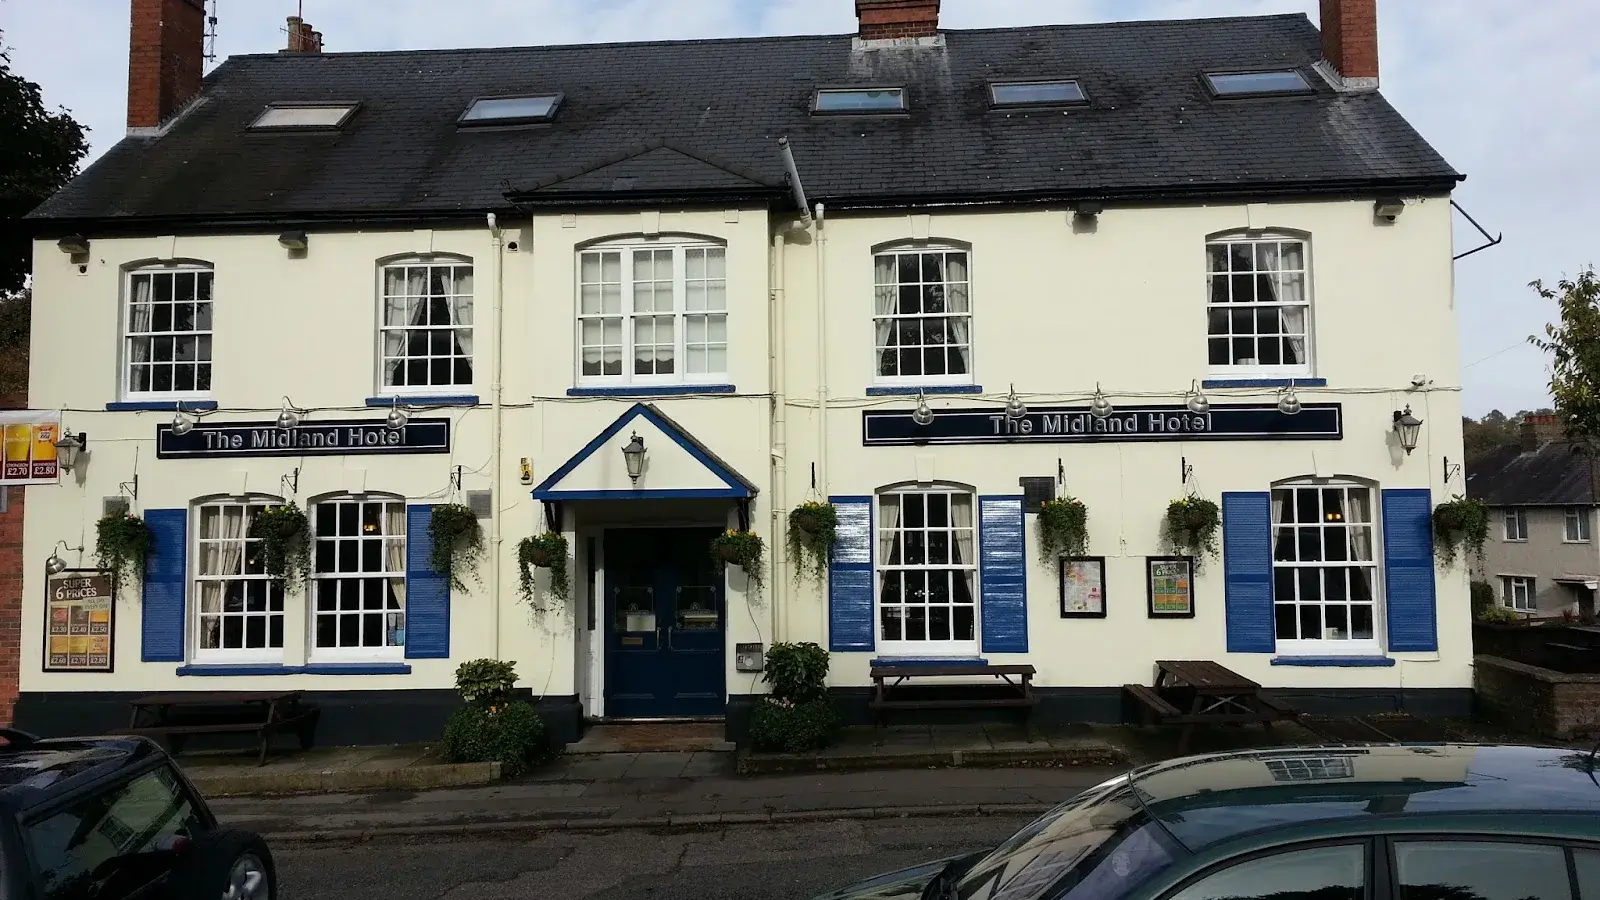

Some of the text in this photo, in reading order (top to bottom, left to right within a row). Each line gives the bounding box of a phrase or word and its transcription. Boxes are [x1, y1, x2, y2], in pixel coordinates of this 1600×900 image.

[989, 412, 1212, 434] The Midland Hotel
[202, 427, 407, 449] The Midland Hotel
[7, 467, 28, 476] £2.70
[34, 466, 55, 475] £2.80
[63, 578, 92, 589] SUPER
[55, 586, 97, 600] 6 PRICES
